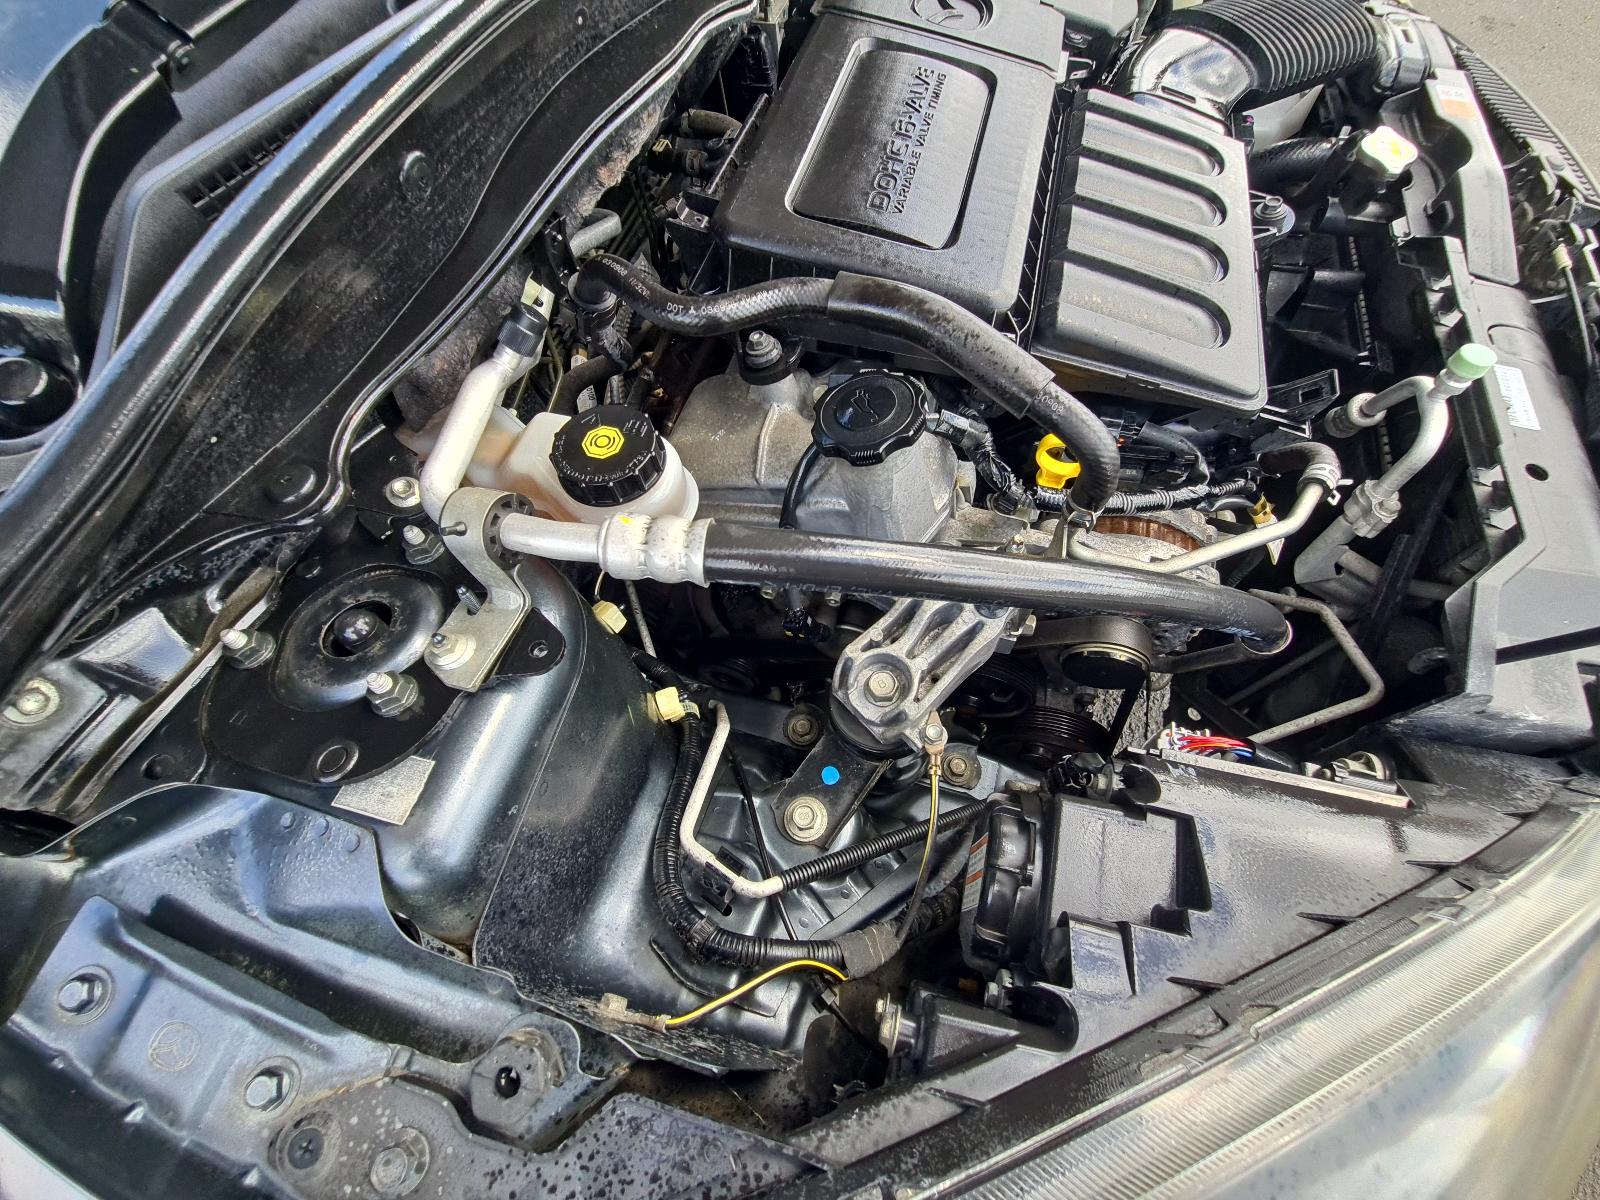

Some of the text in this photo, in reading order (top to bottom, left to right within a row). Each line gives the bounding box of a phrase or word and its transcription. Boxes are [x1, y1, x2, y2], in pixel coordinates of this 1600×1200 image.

[867, 66, 935, 212] DOHC 16-VALVE
[893, 72, 947, 214] VARIABLE VALVE TIMING
[666, 301, 684, 313] DOT
